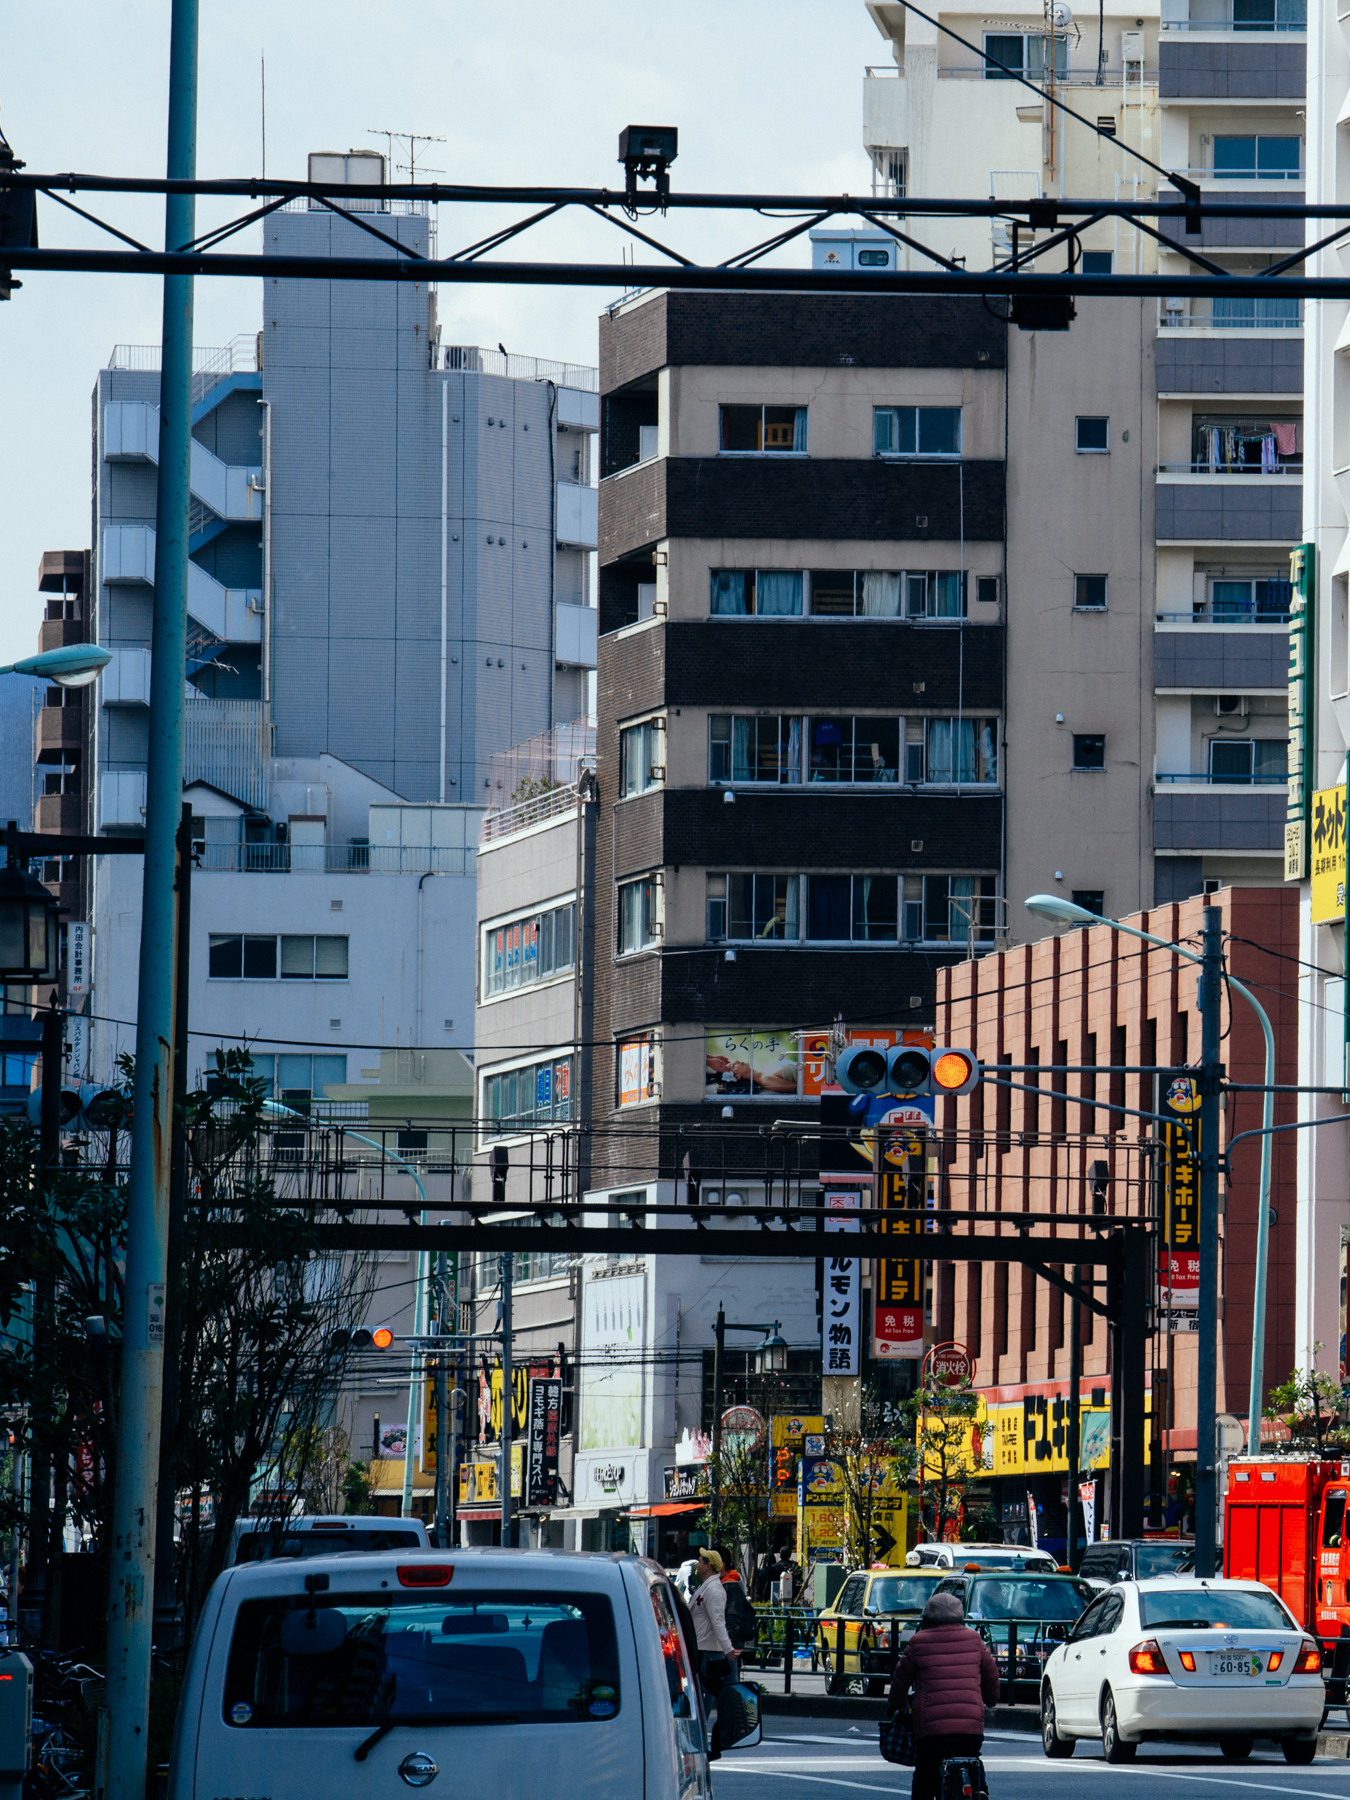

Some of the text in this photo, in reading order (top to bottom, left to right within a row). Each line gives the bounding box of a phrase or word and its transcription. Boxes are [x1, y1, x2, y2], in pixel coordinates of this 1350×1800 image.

[73, 926, 84, 984] 内田会計事務所
[724, 1035, 780, 1053] らくの手
[1170, 1259, 1200, 1272] 免税
[829, 1228, 853, 1370] ルモン物語
[884, 1315, 915, 1327] 免税
[935, 1360, 968, 1376] 消火栓
[531, 1385, 545, 1486] ヨモギ蒸し専門スパ
[1220, 1661, 1251, 1673] 60-85
[403, 1765, 435, 1774] NISSAN
